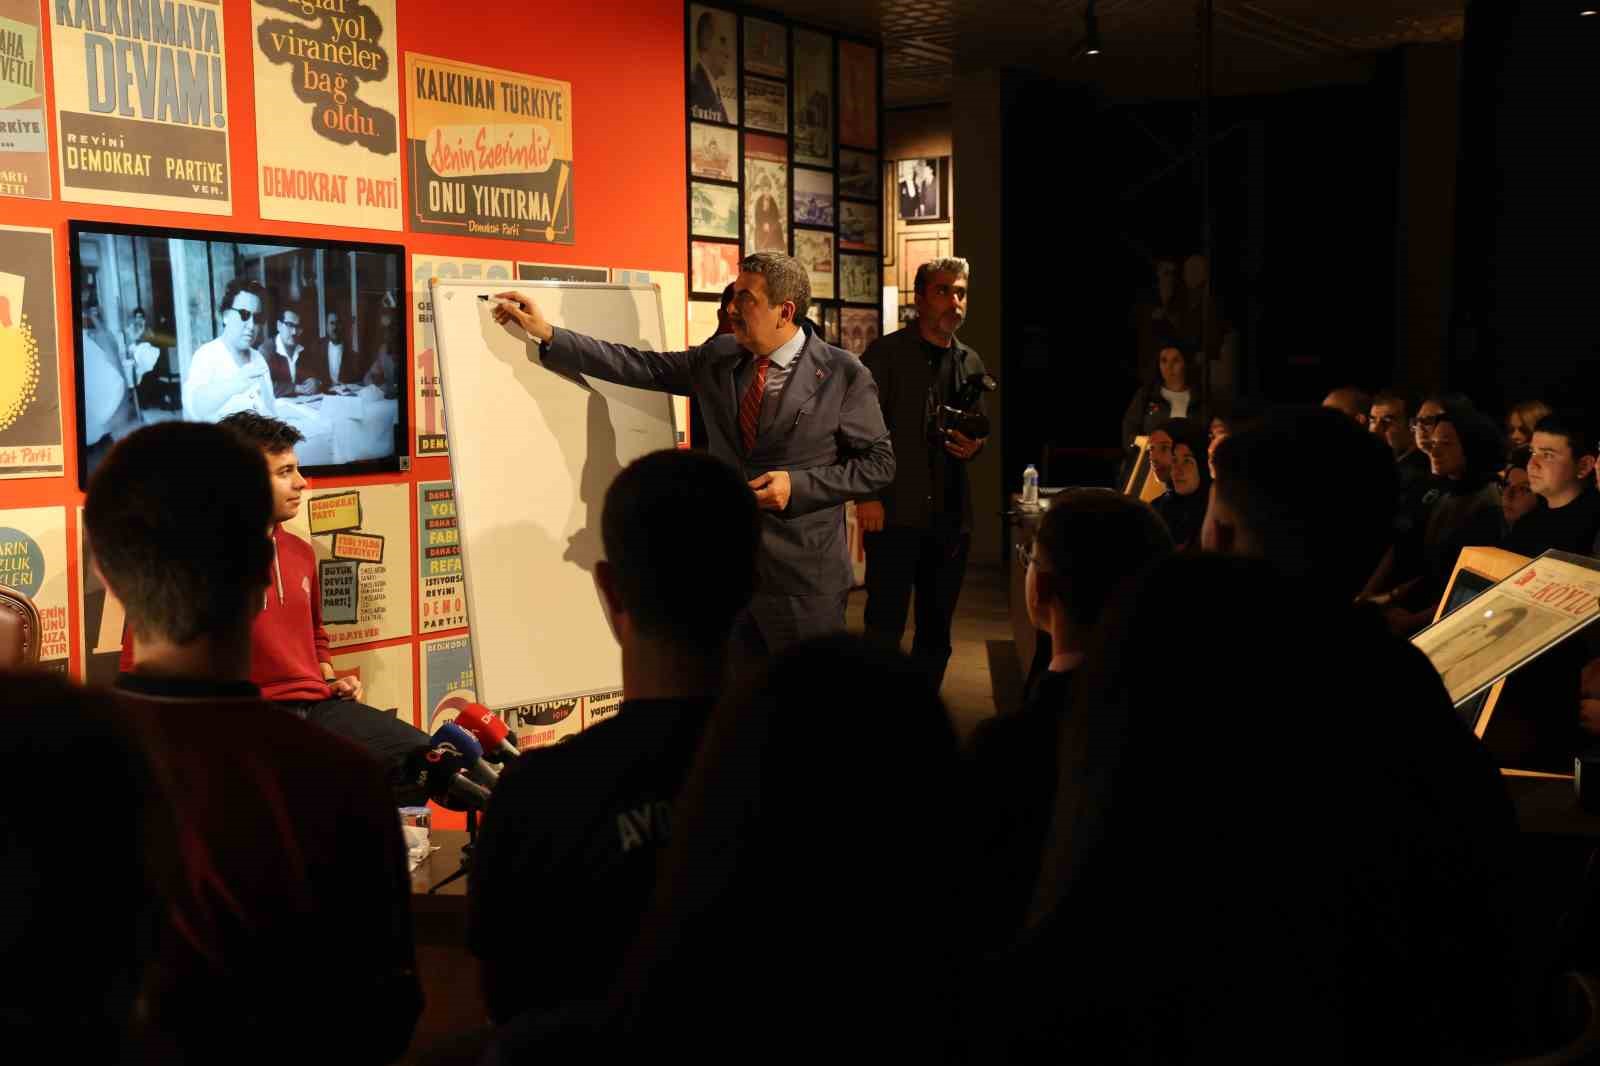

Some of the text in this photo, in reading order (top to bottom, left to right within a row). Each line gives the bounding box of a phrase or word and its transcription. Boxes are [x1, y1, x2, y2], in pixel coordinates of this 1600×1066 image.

[271, 29, 381, 70] viraneler
[85, 32, 225, 128] DEVAM!
[303, 61, 347, 105] bağ
[416, 67, 562, 121] KALKINAN TÜRKİYE
[322, 105, 380, 137] oldu.
[67, 146, 224, 184] DEMOKRAT PARTİYE
[263, 166, 399, 209] DEMOKRAT PARTİ
[429, 180, 466, 214] ONU
